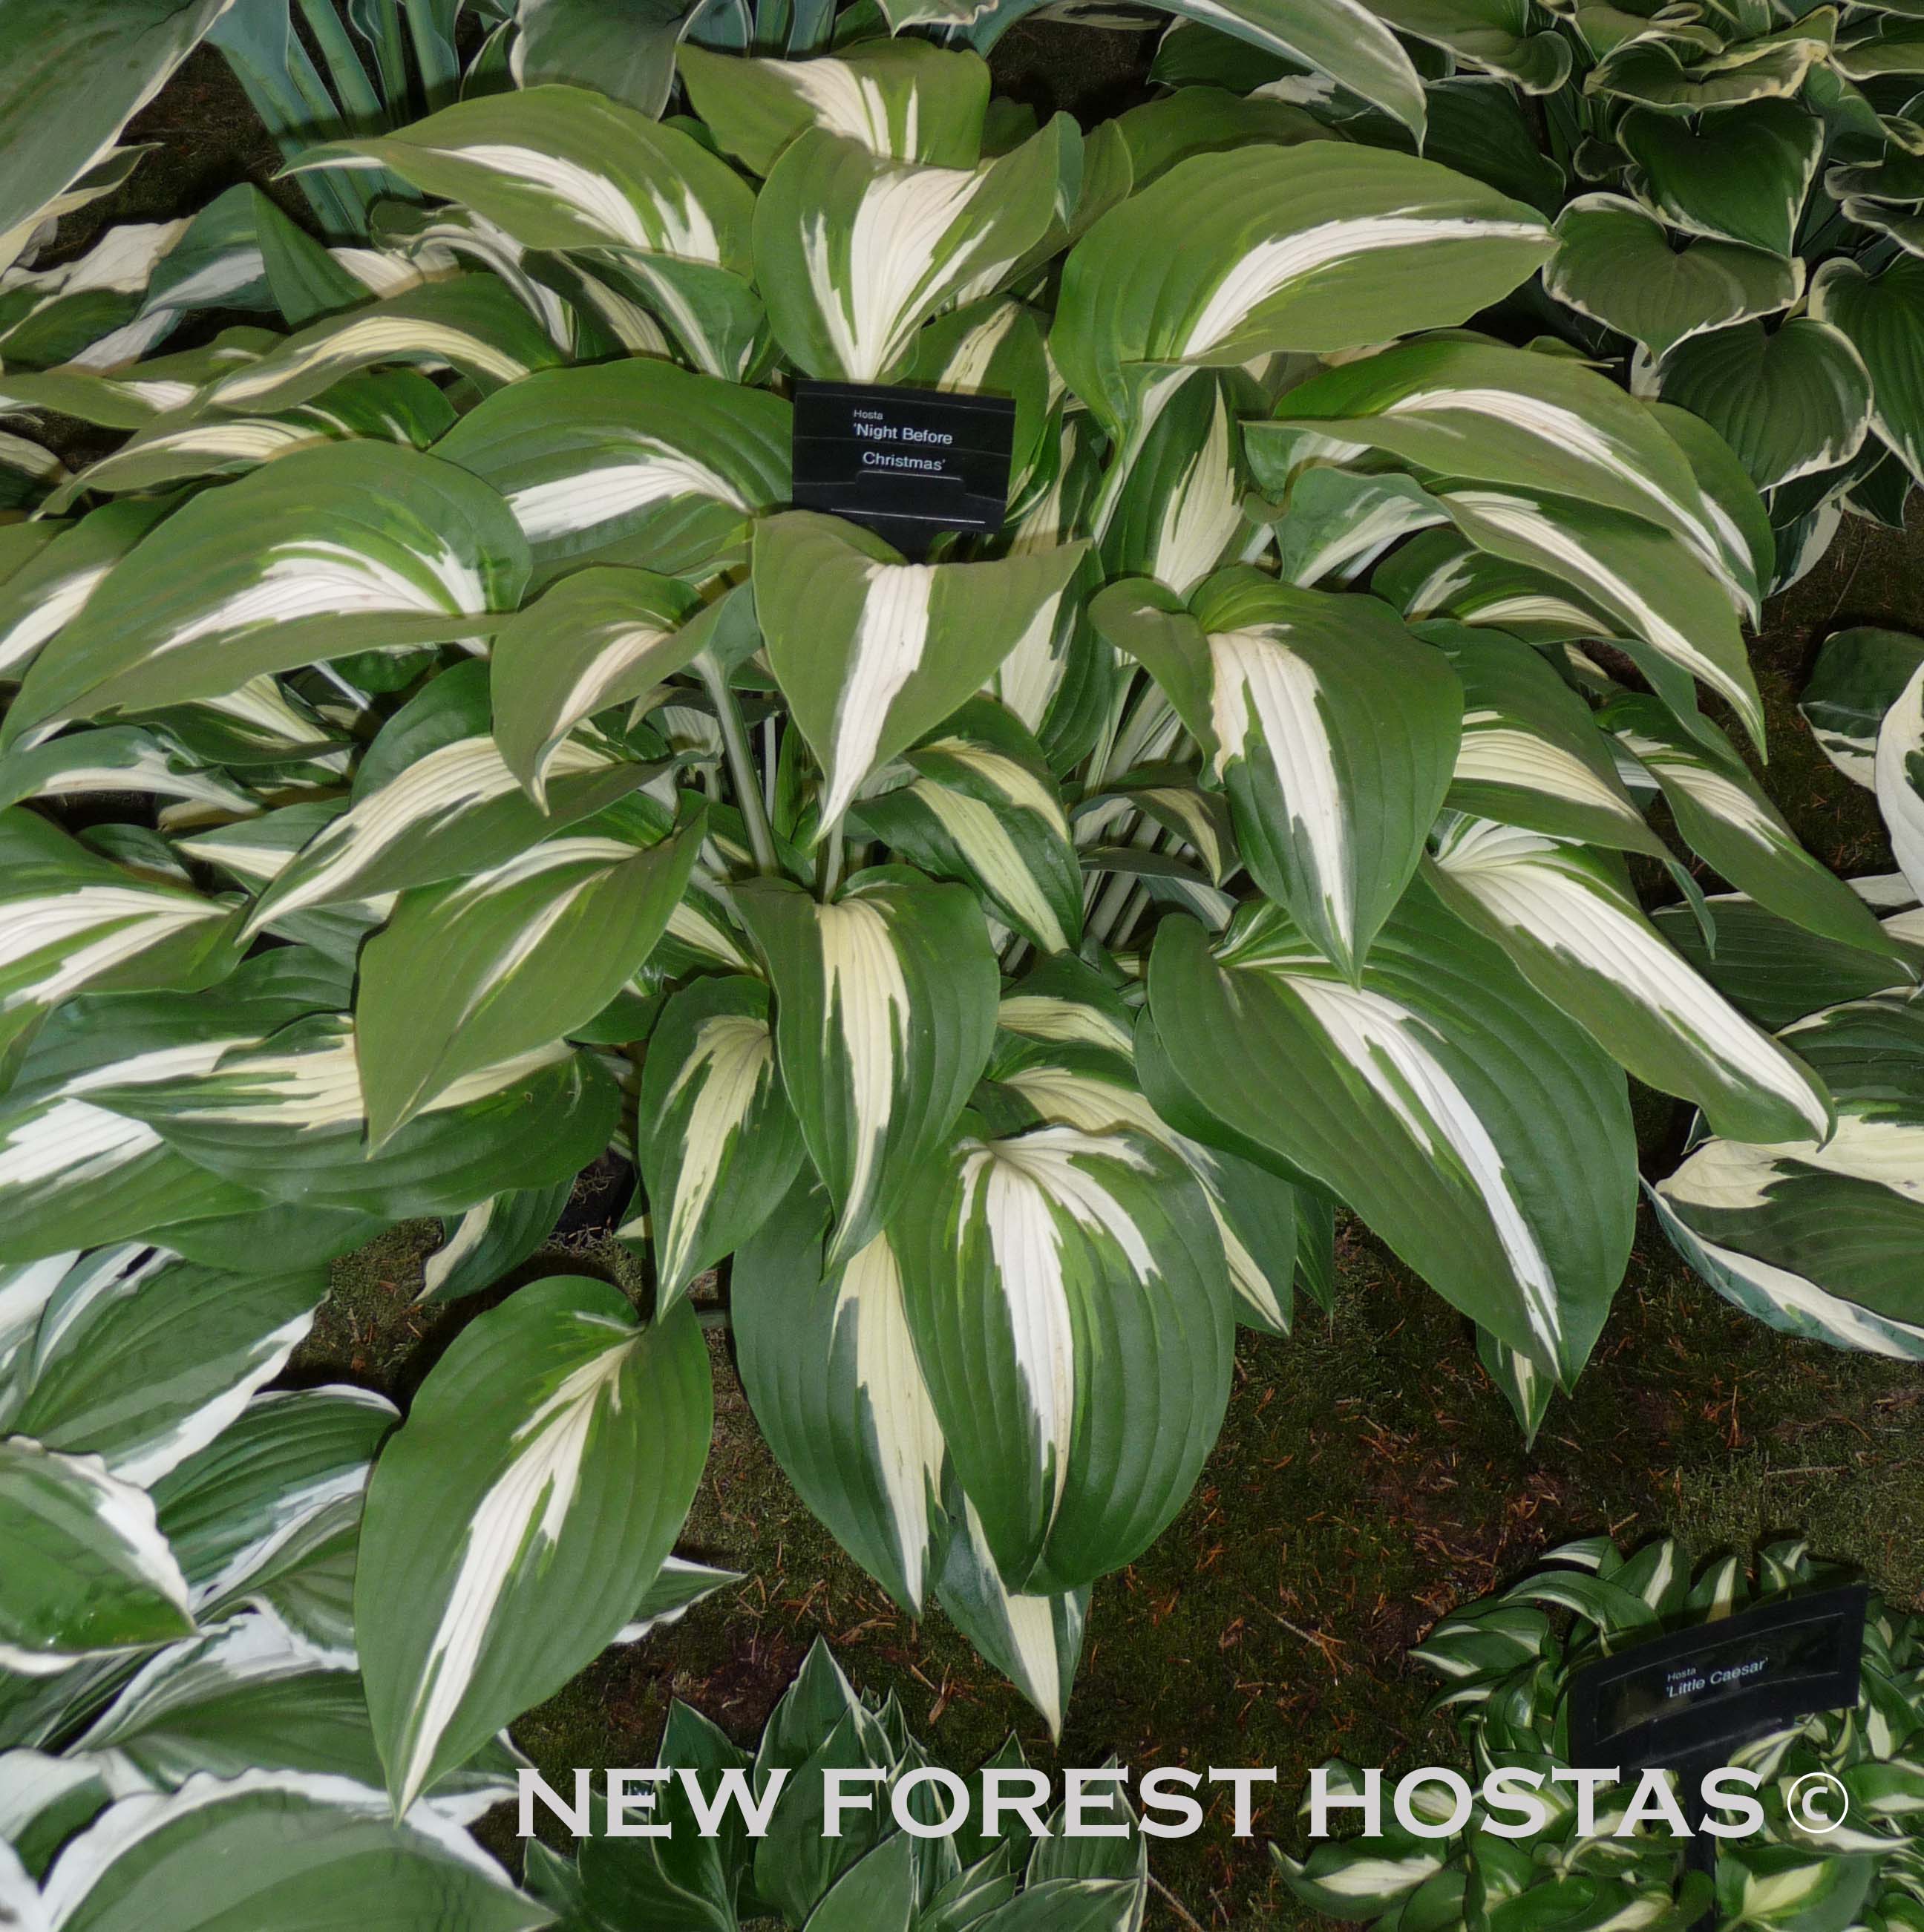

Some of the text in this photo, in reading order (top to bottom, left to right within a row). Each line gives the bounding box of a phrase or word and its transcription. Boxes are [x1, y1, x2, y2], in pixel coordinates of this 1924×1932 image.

[853, 409, 883, 420] Hosta
[902, 427, 953, 445] Before
[1667, 1667, 1696, 1682] Hosta
